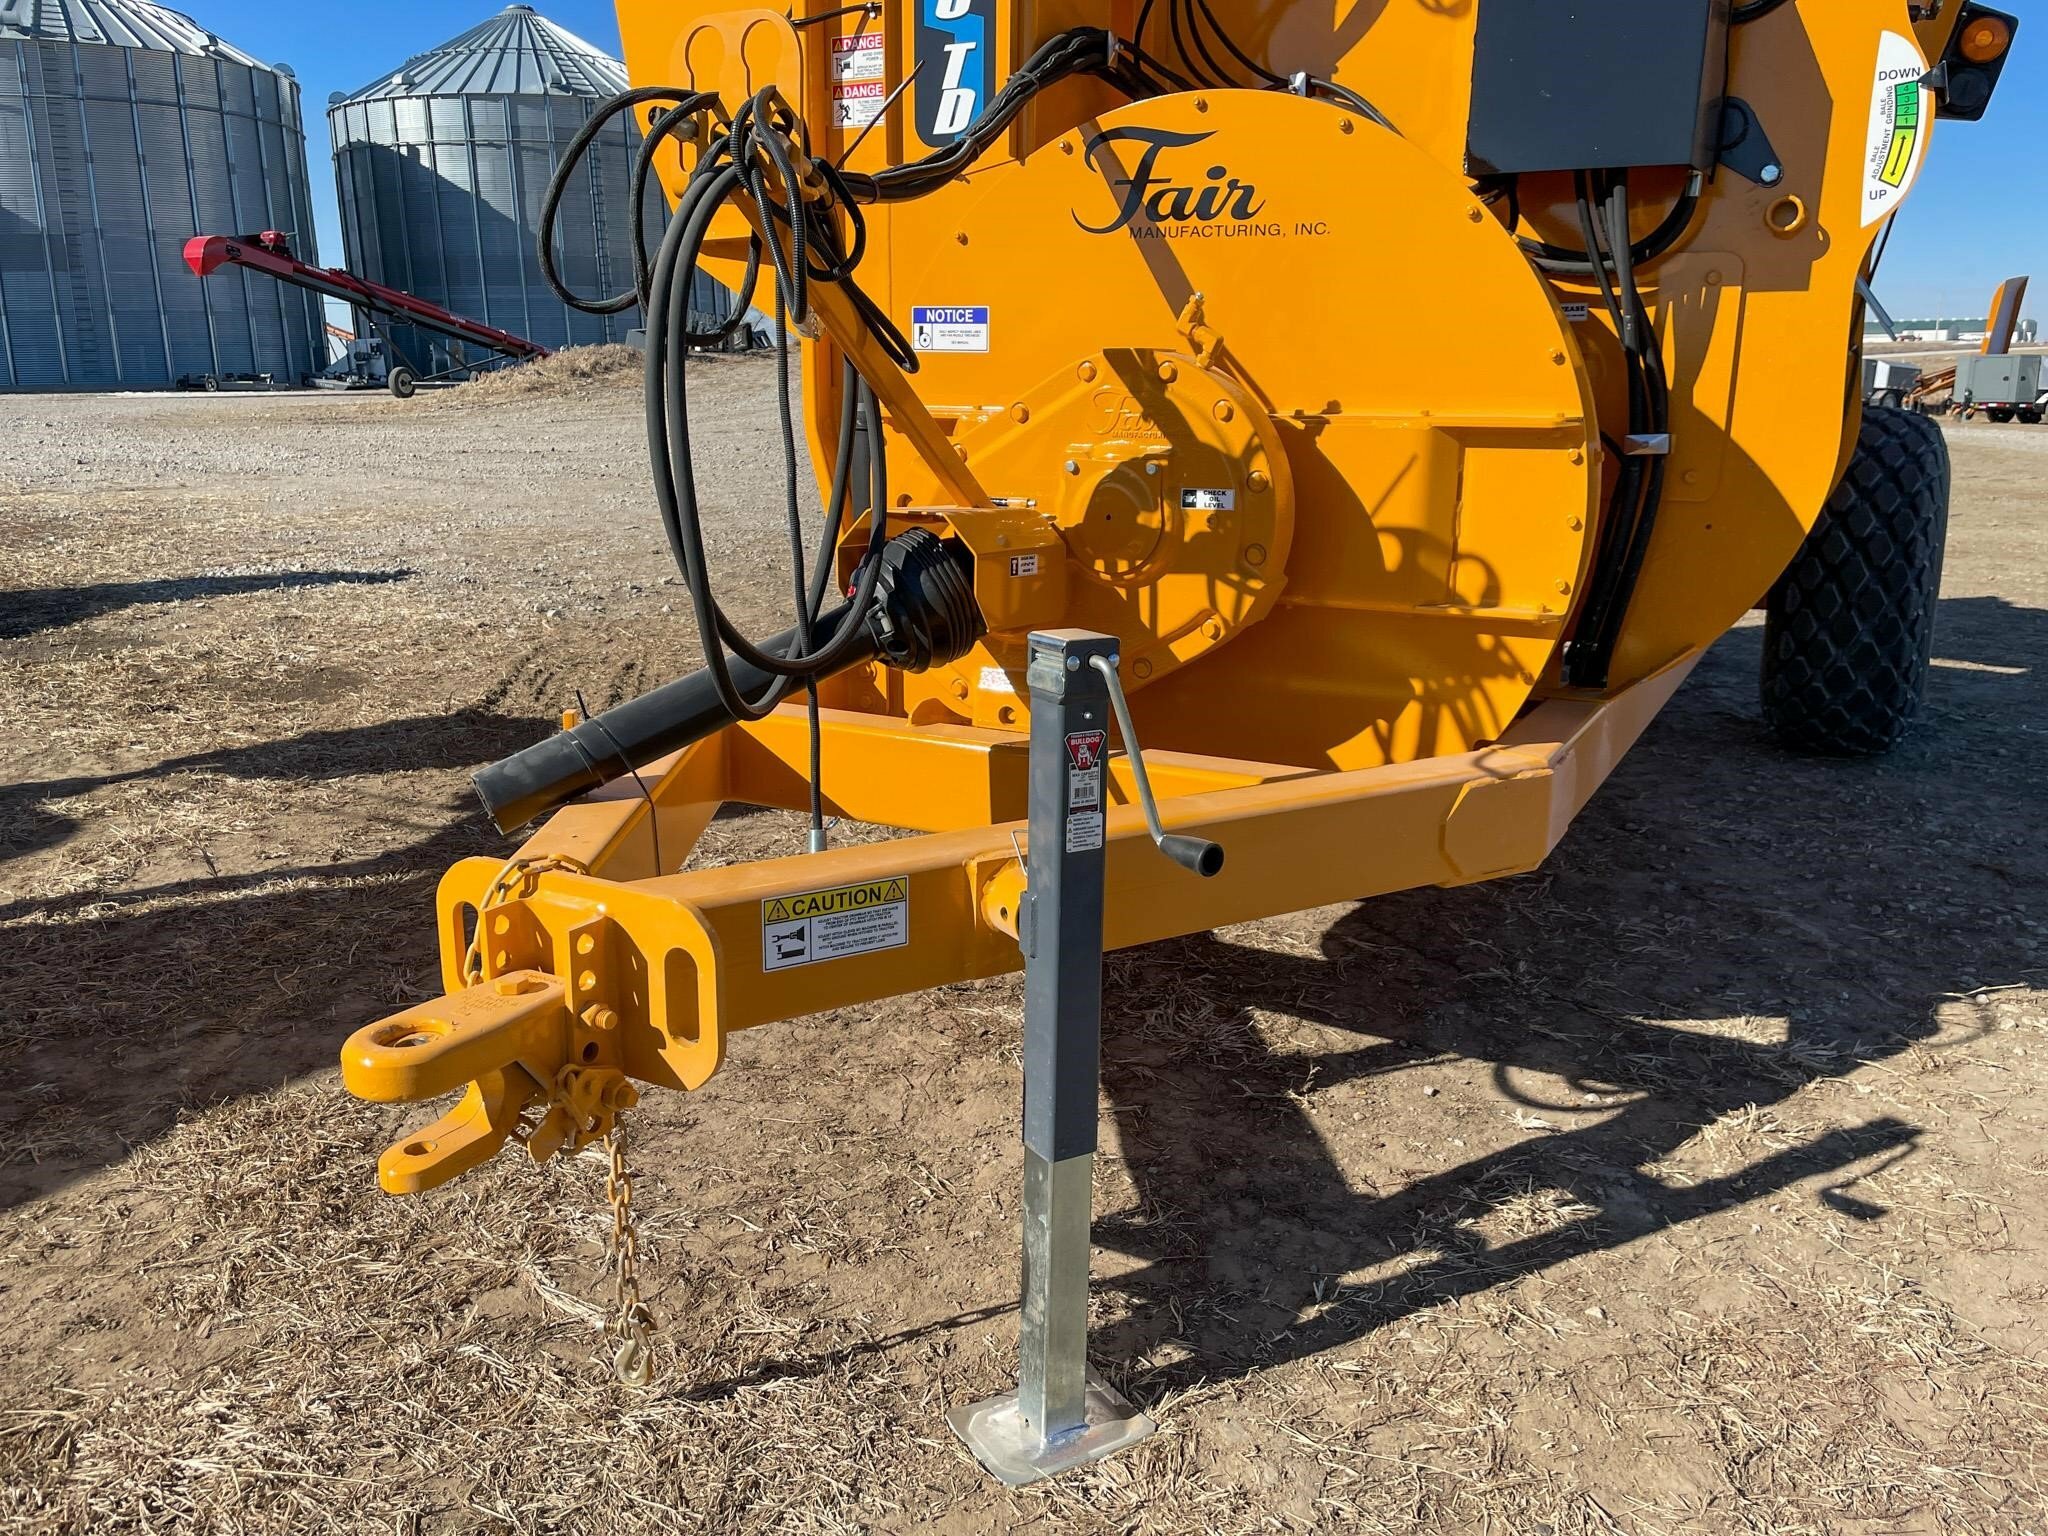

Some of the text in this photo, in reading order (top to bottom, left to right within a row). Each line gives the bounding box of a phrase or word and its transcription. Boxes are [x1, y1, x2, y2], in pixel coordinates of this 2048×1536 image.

[843, 36, 882, 51] DANGE
[1878, 66, 1920, 81] DOWN
[844, 84, 883, 98] DANGE
[1870, 146, 1880, 163] BALE
[1872, 128, 1891, 180] ADJUSTMENT
[1071, 126, 1266, 234] Fair
[1869, 189, 1887, 200] UP
[1129, 222, 1331, 239] MANUFACTURING, INC.
[926, 309, 974, 322] NOTICE
[1071, 736, 1100, 745] BULLDOG
[792, 886, 881, 915] CAUTION
